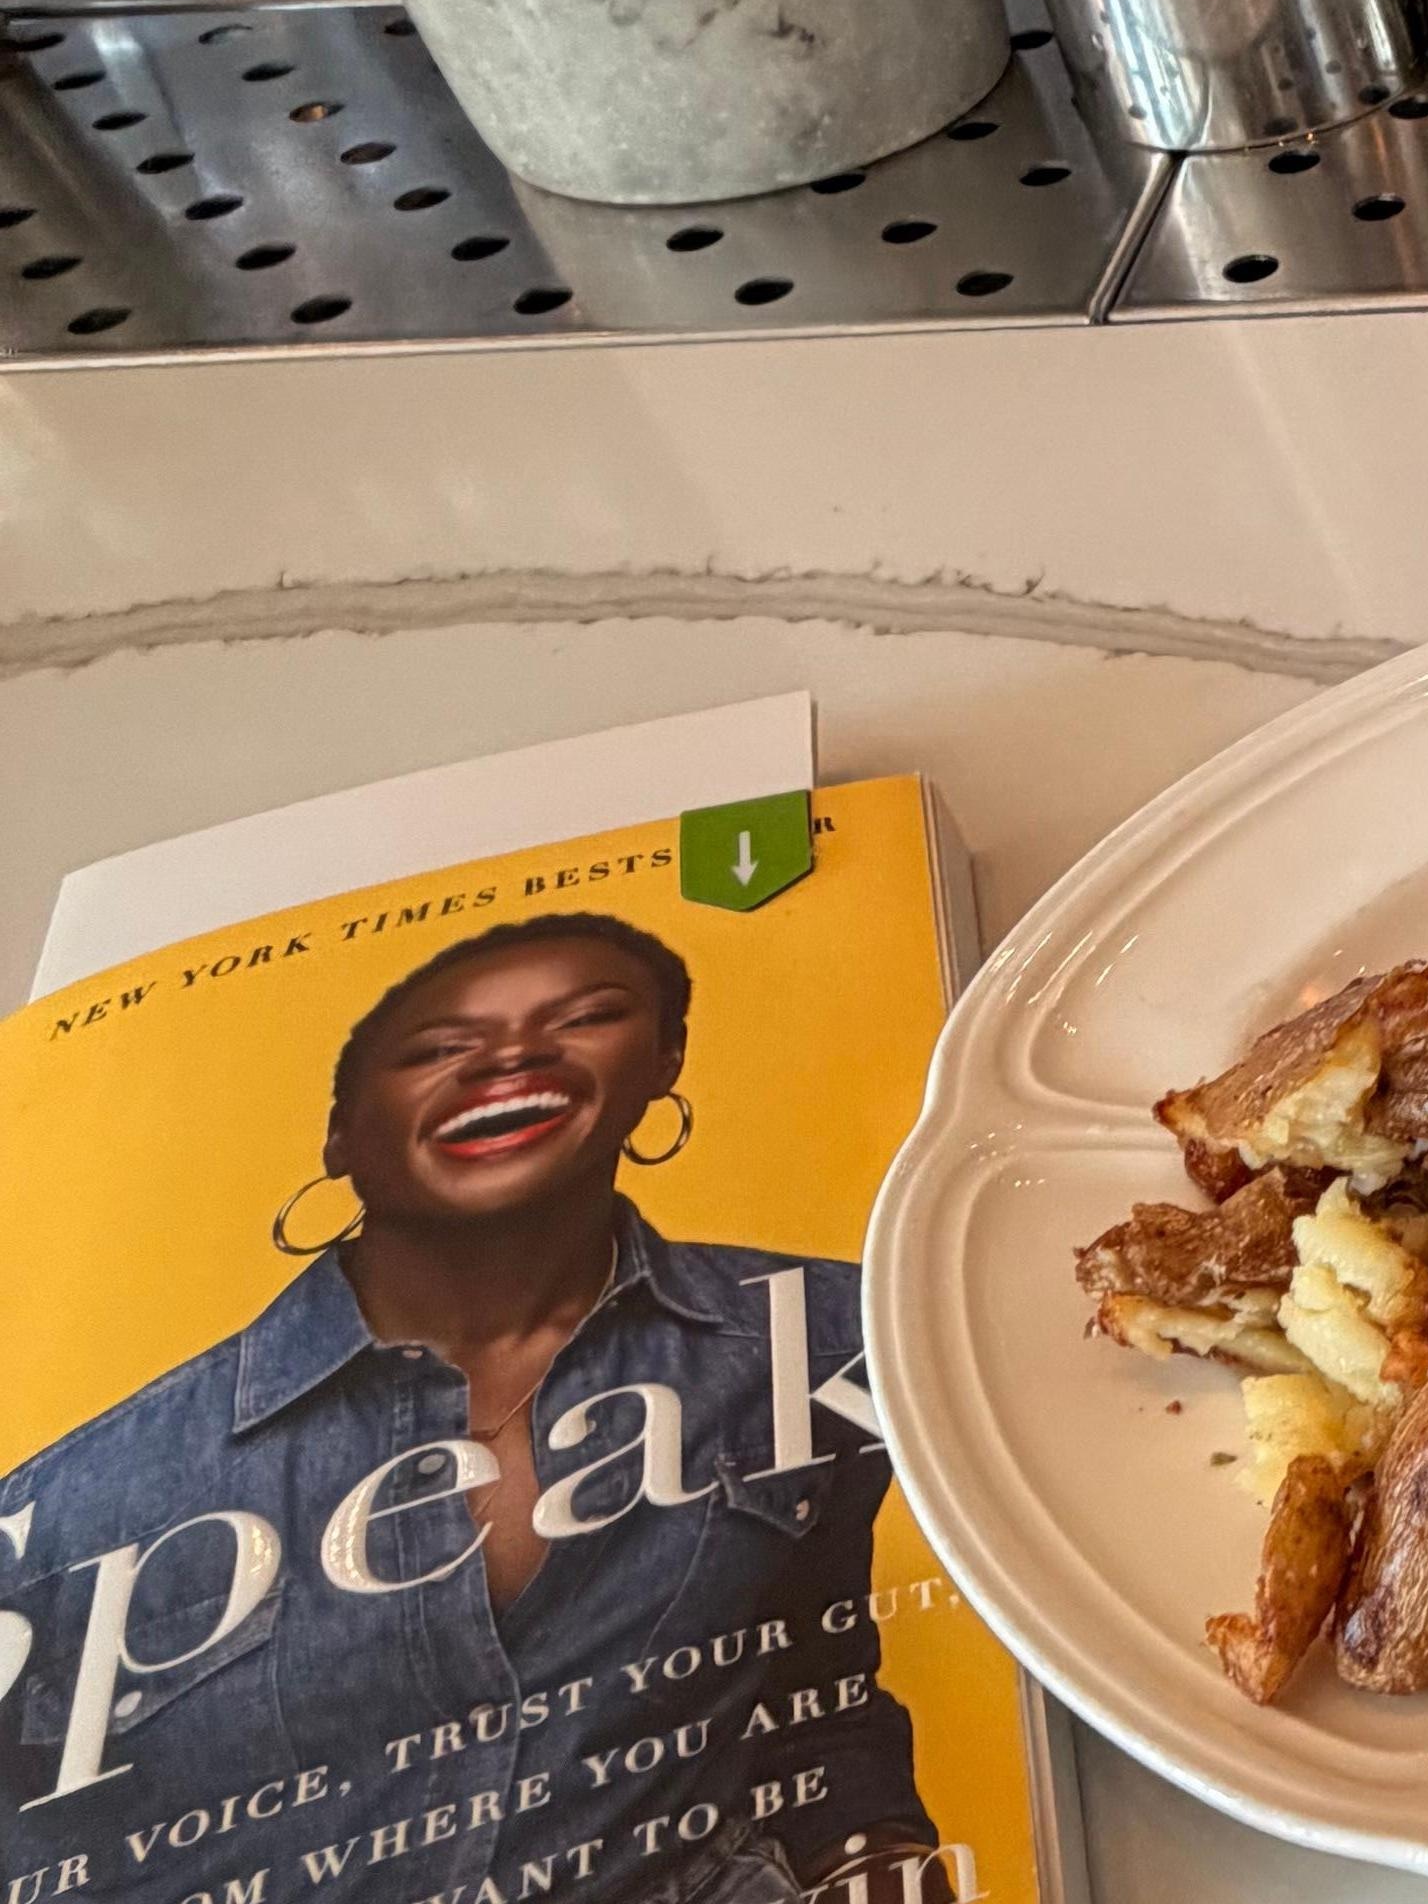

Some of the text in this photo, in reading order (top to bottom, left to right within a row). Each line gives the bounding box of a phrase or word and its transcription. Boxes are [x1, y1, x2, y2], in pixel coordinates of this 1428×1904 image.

[50, 816, 837, 1041] NEW YORK TIMES BESTSR
[126, 1765, 352, 1863] VOICE,
[385, 1676, 594, 1774] TRUST
[621, 1619, 794, 1696] YOUR
[821, 1577, 960, 1636] GUT,
[300, 1771, 552, 1885] WHERE
[581, 1717, 715, 1791] YOU
[741, 1672, 871, 1741] ARE
[633, 1801, 720, 1857] TO
[750, 1765, 830, 1821] BE
